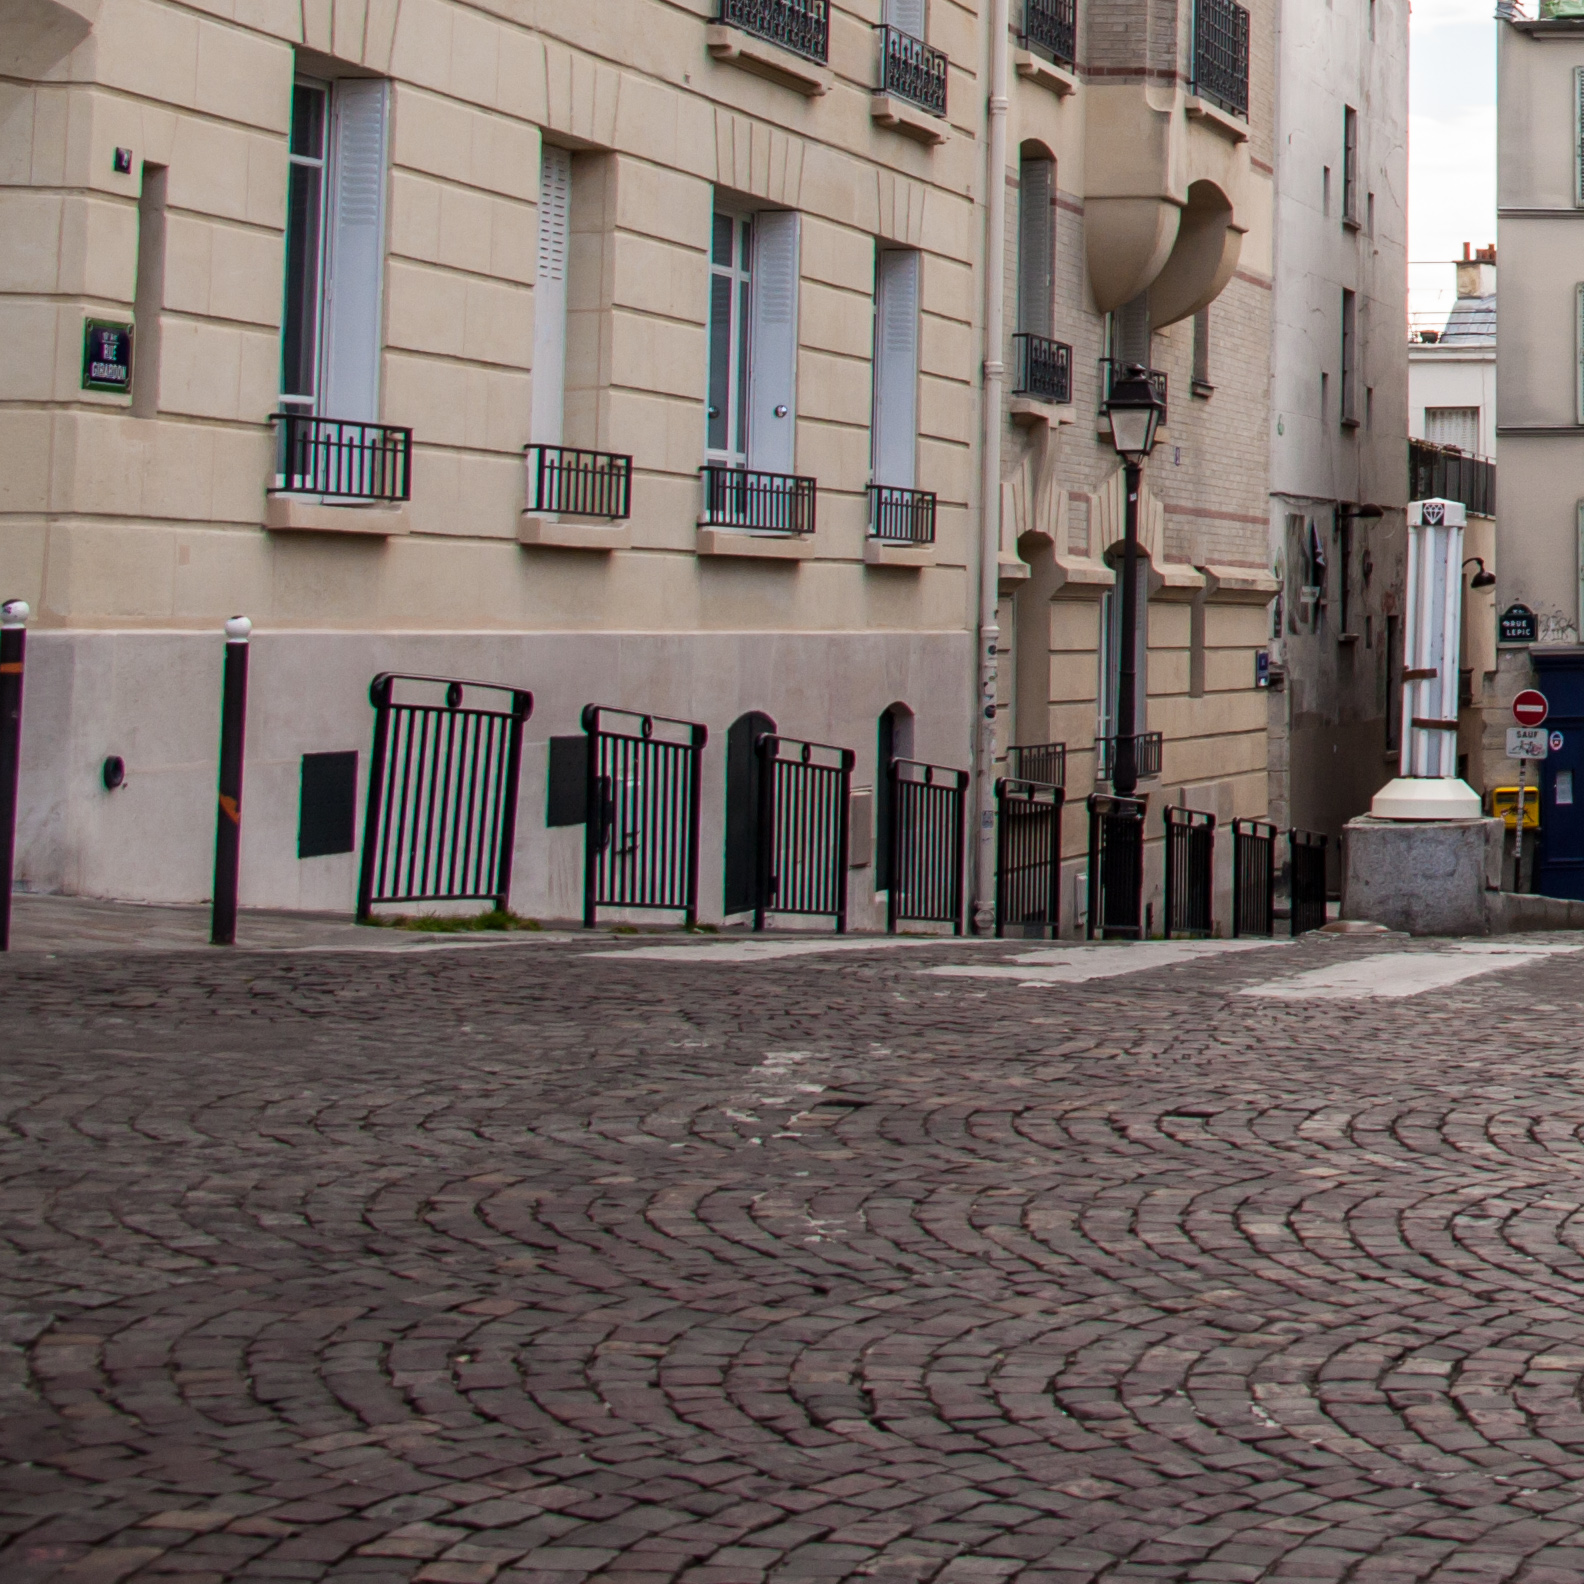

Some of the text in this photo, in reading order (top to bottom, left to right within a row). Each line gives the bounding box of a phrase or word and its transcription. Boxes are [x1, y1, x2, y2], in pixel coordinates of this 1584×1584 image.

[1511, 619, 1527, 627] RUE
[1506, 628, 1531, 636] LEPIC
[1516, 730, 1539, 739] SAUF
